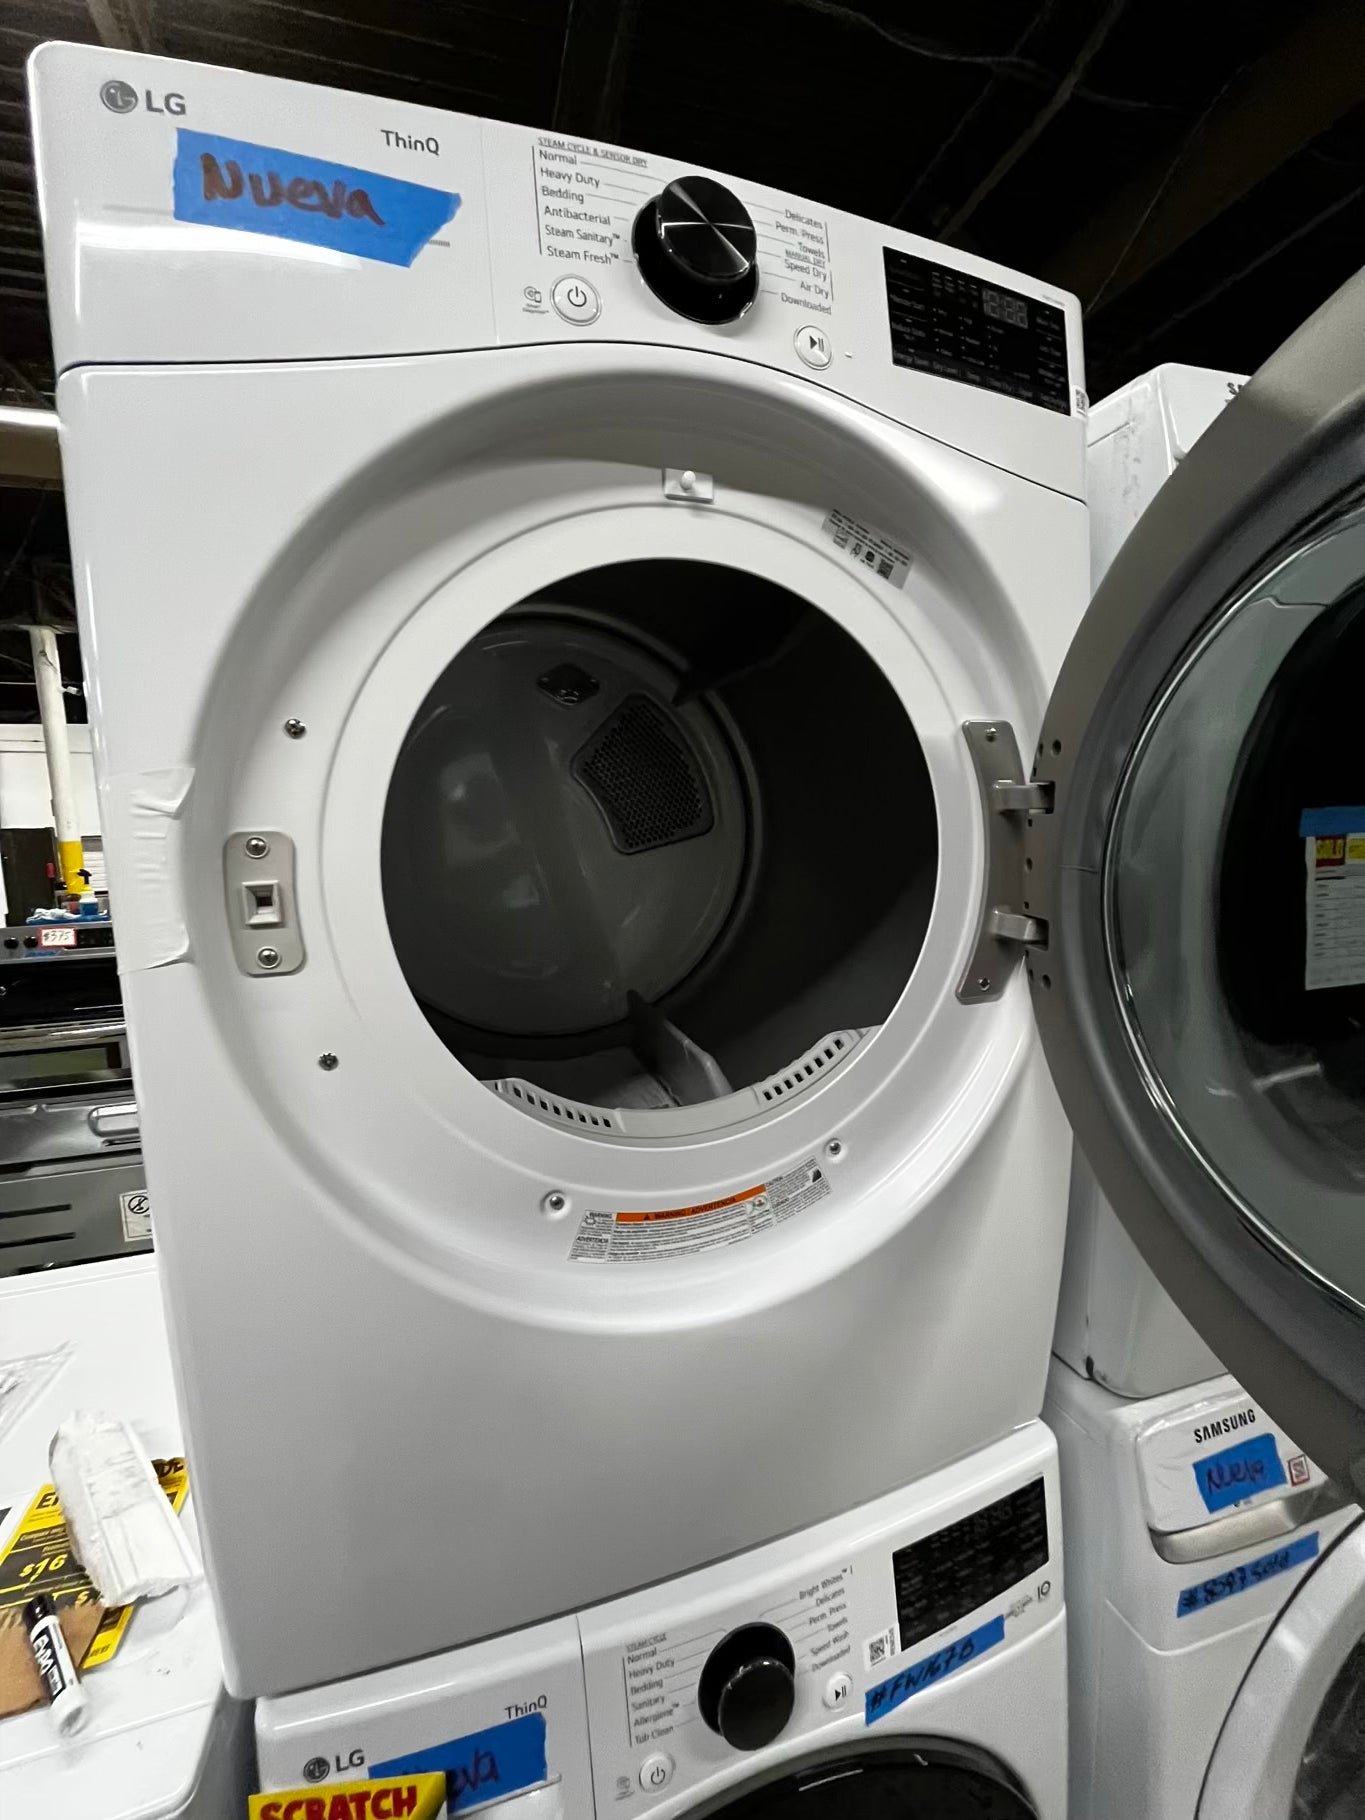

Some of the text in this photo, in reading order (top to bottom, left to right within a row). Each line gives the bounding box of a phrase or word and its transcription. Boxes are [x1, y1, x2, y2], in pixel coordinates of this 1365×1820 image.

[144, 89, 187, 116] LG
[380, 129, 440, 156] ThinQ
[539, 149, 578, 165] Normal
[541, 167, 600, 188] Heavy Duty
[541, 185, 584, 204] Bedding
[544, 205, 611, 225] Antibacterial
[785, 208, 823, 230] Delicates
[545, 224, 575, 239] Steam
[801, 229, 825, 245] Press
[546, 245, 581, 260] Steam
[798, 242, 826, 259] Towels
[784, 259, 827, 283] Speed Dry
[800, 280, 829, 300] Air Dry
[781, 292, 832, 316] Downloaded
[1193, 1408, 1257, 1444] SAMSUNG
[627, 1647, 658, 1665] Normal
[628, 1658, 675, 1680] Heavy Duty
[630, 1678, 664, 1696] Bedding
[505, 1694, 548, 1720] ThinQ
[631, 1694, 665, 1712] Sanitary
[335, 1748, 365, 1772] LG
[260, 1785, 418, 1820] SCRATCH
